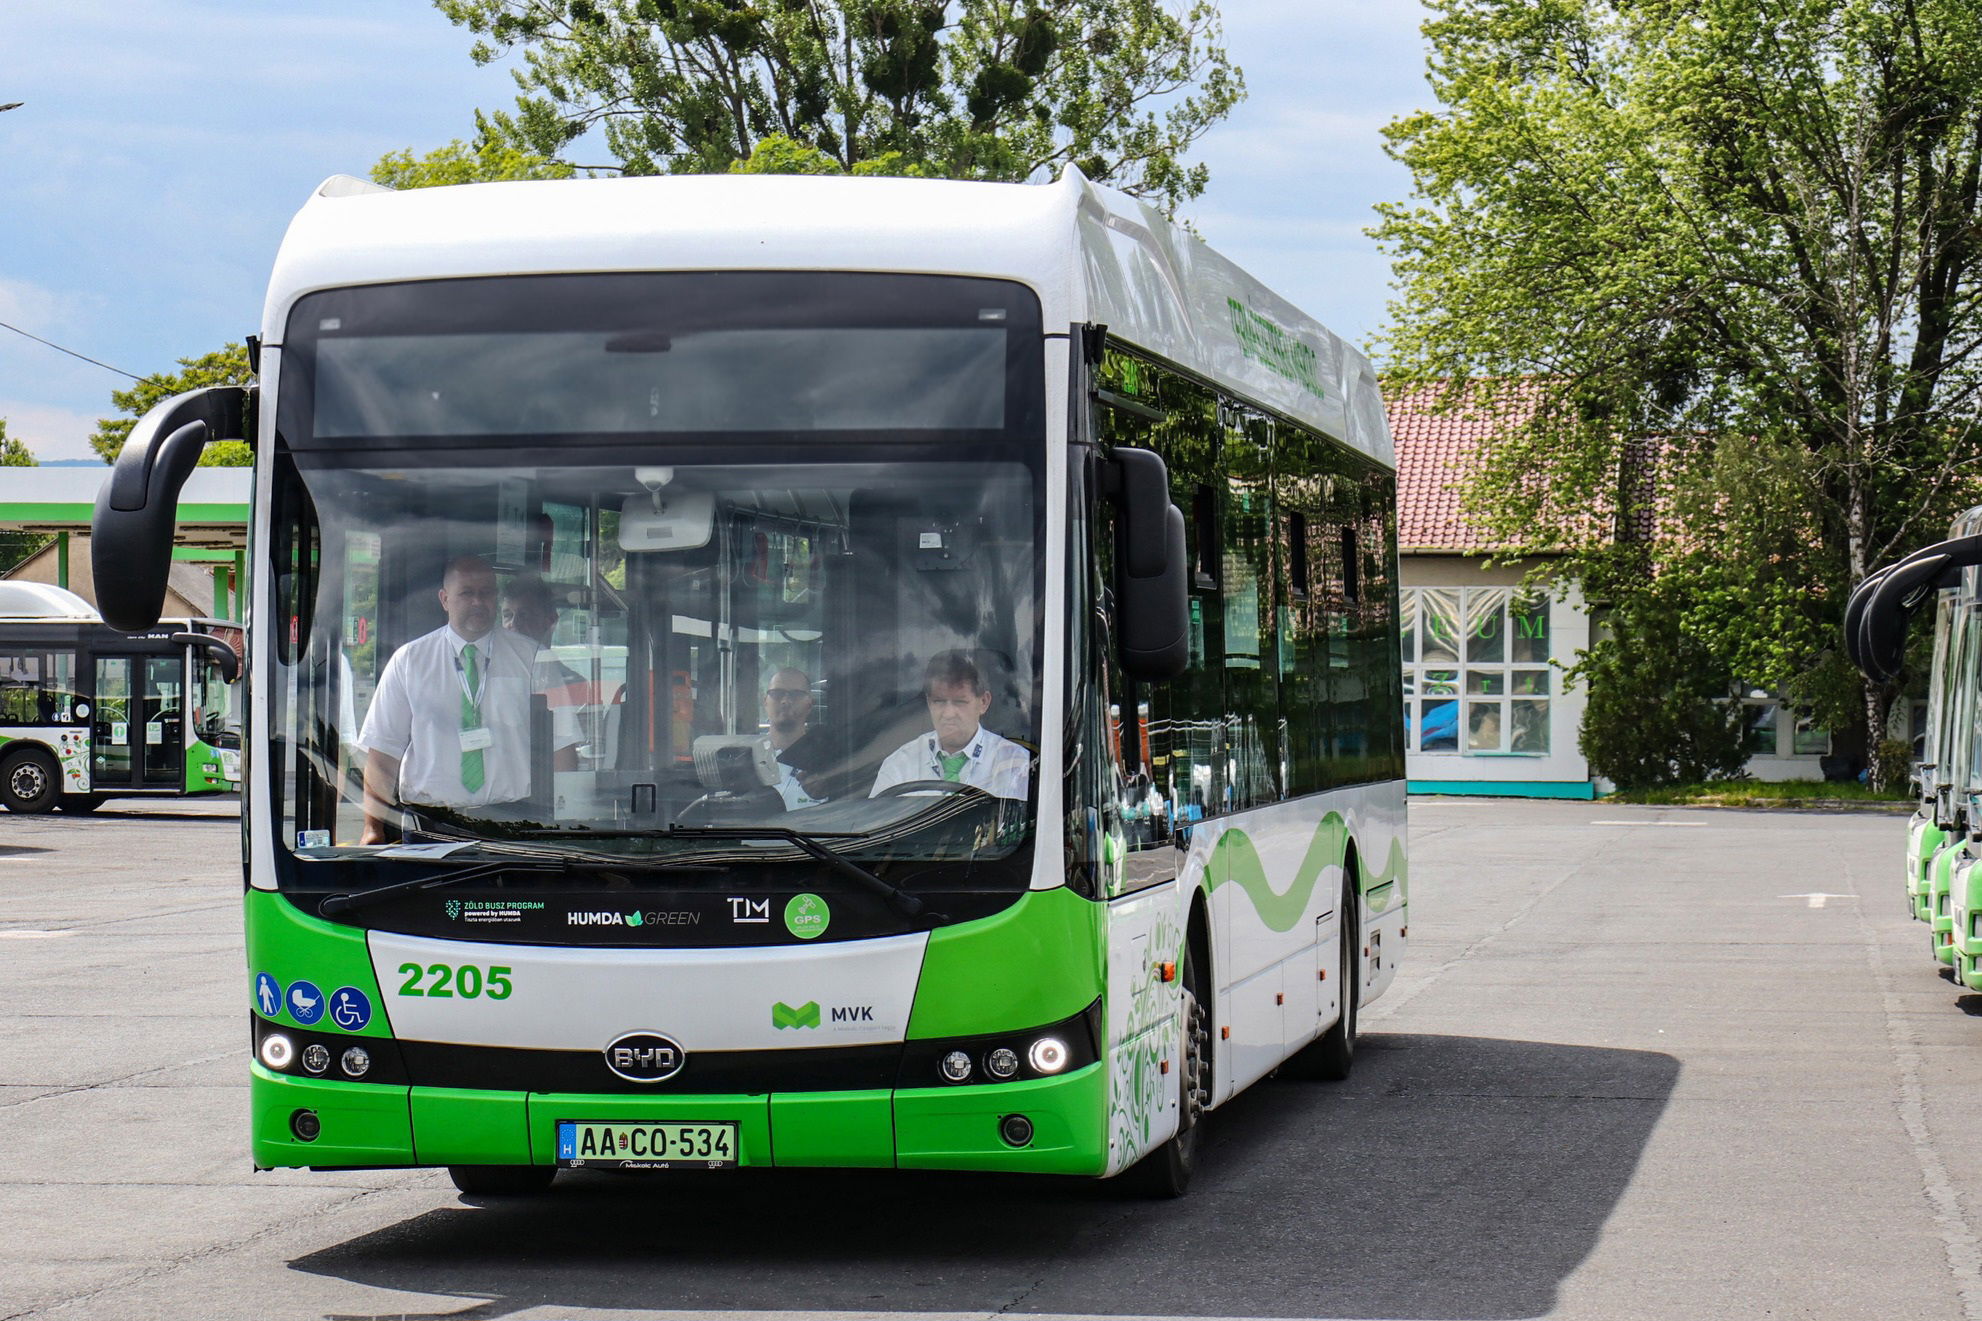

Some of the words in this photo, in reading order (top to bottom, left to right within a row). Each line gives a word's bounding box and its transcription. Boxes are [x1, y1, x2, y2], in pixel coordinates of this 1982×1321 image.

[485, 902, 505, 910] BUSZ
[506, 901, 545, 909] PROGRAM
[464, 910, 490, 918] powered
[490, 910, 498, 918] by
[567, 912, 624, 925] HUMDA
[644, 911, 700, 925] GREEN
[794, 914, 821, 925] GPS
[398, 962, 512, 1000] 2205
[831, 1006, 873, 1022] MVK
[614, 1048, 675, 1068] BYD
[581, 1128, 616, 1156] AA
[563, 1144, 572, 1155] H
